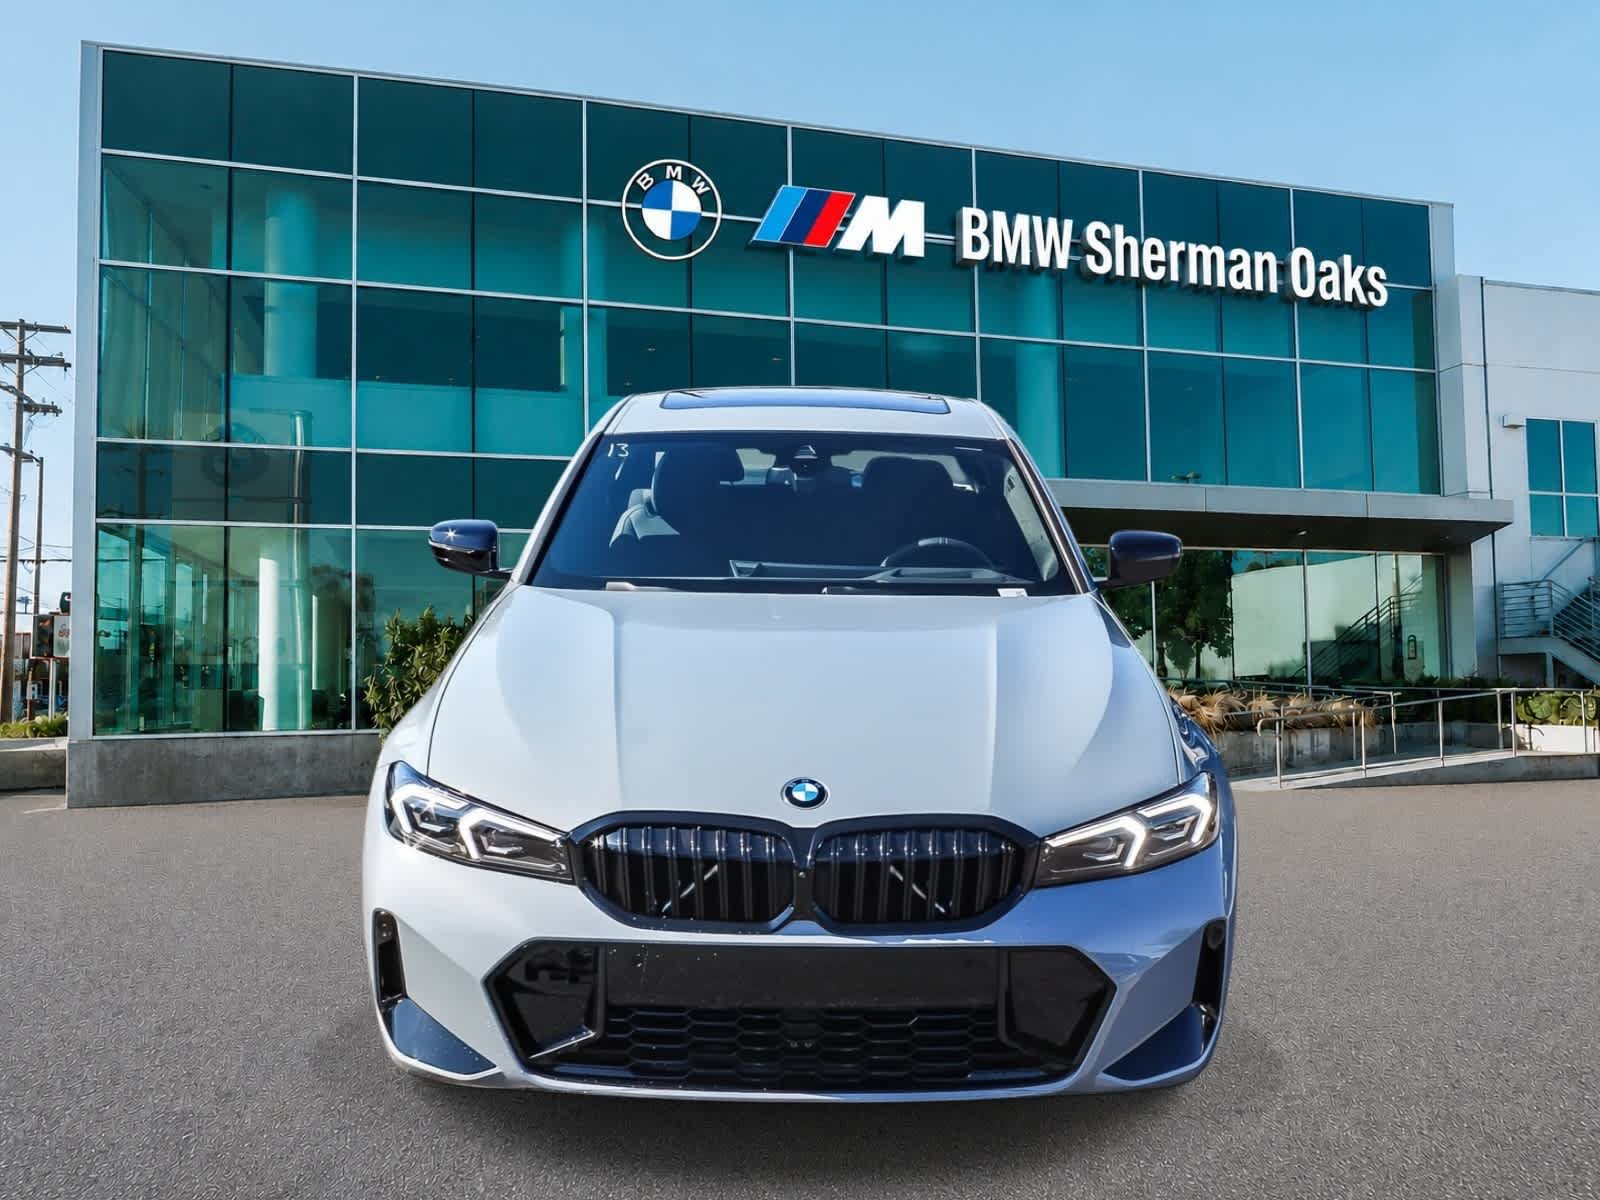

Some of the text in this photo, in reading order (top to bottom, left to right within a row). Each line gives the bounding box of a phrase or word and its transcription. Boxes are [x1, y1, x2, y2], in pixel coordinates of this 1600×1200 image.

[636, 165, 711, 196] BMW
[835, 195, 925, 258] M
[959, 206, 1388, 308] BMW Sherman Oaks
